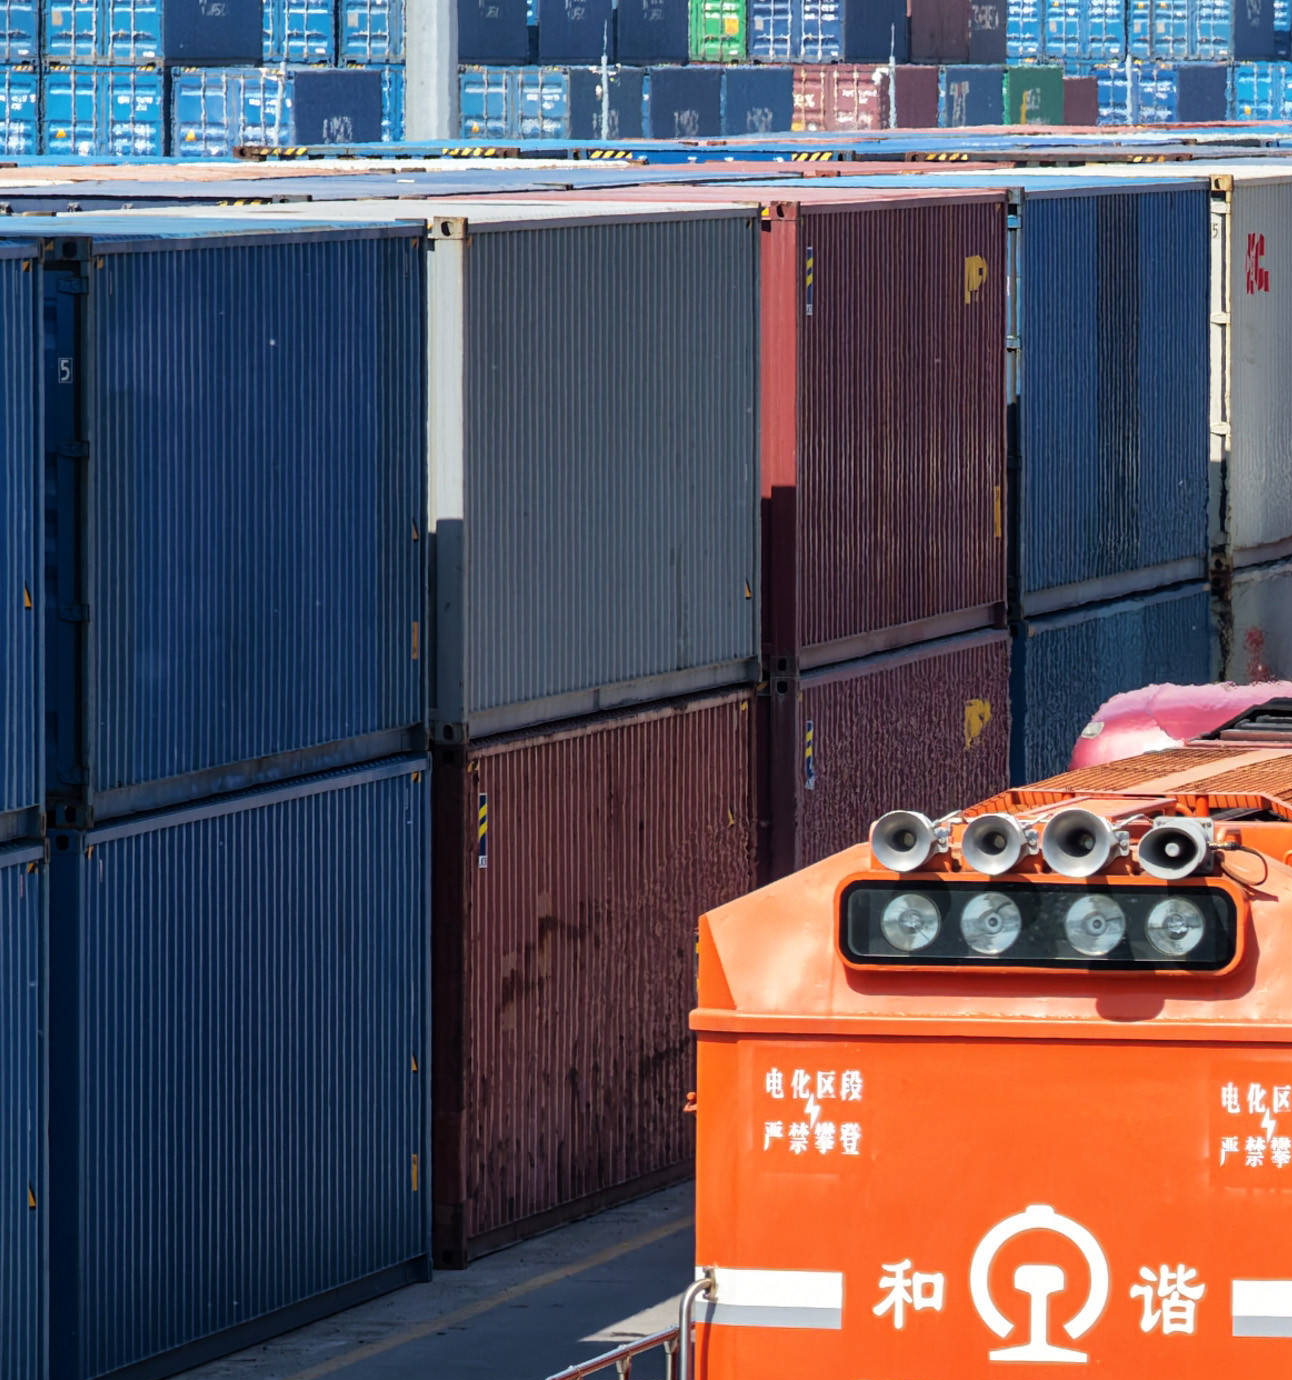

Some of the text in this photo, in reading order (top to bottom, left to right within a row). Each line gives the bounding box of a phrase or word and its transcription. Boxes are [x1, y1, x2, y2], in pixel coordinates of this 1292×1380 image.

[60, 360, 70, 381] 5
[765, 1067, 863, 1103] 电化区段
[763, 1120, 862, 1156] 严禁攀登
[872, 1258, 1206, 1336] 和 谐
